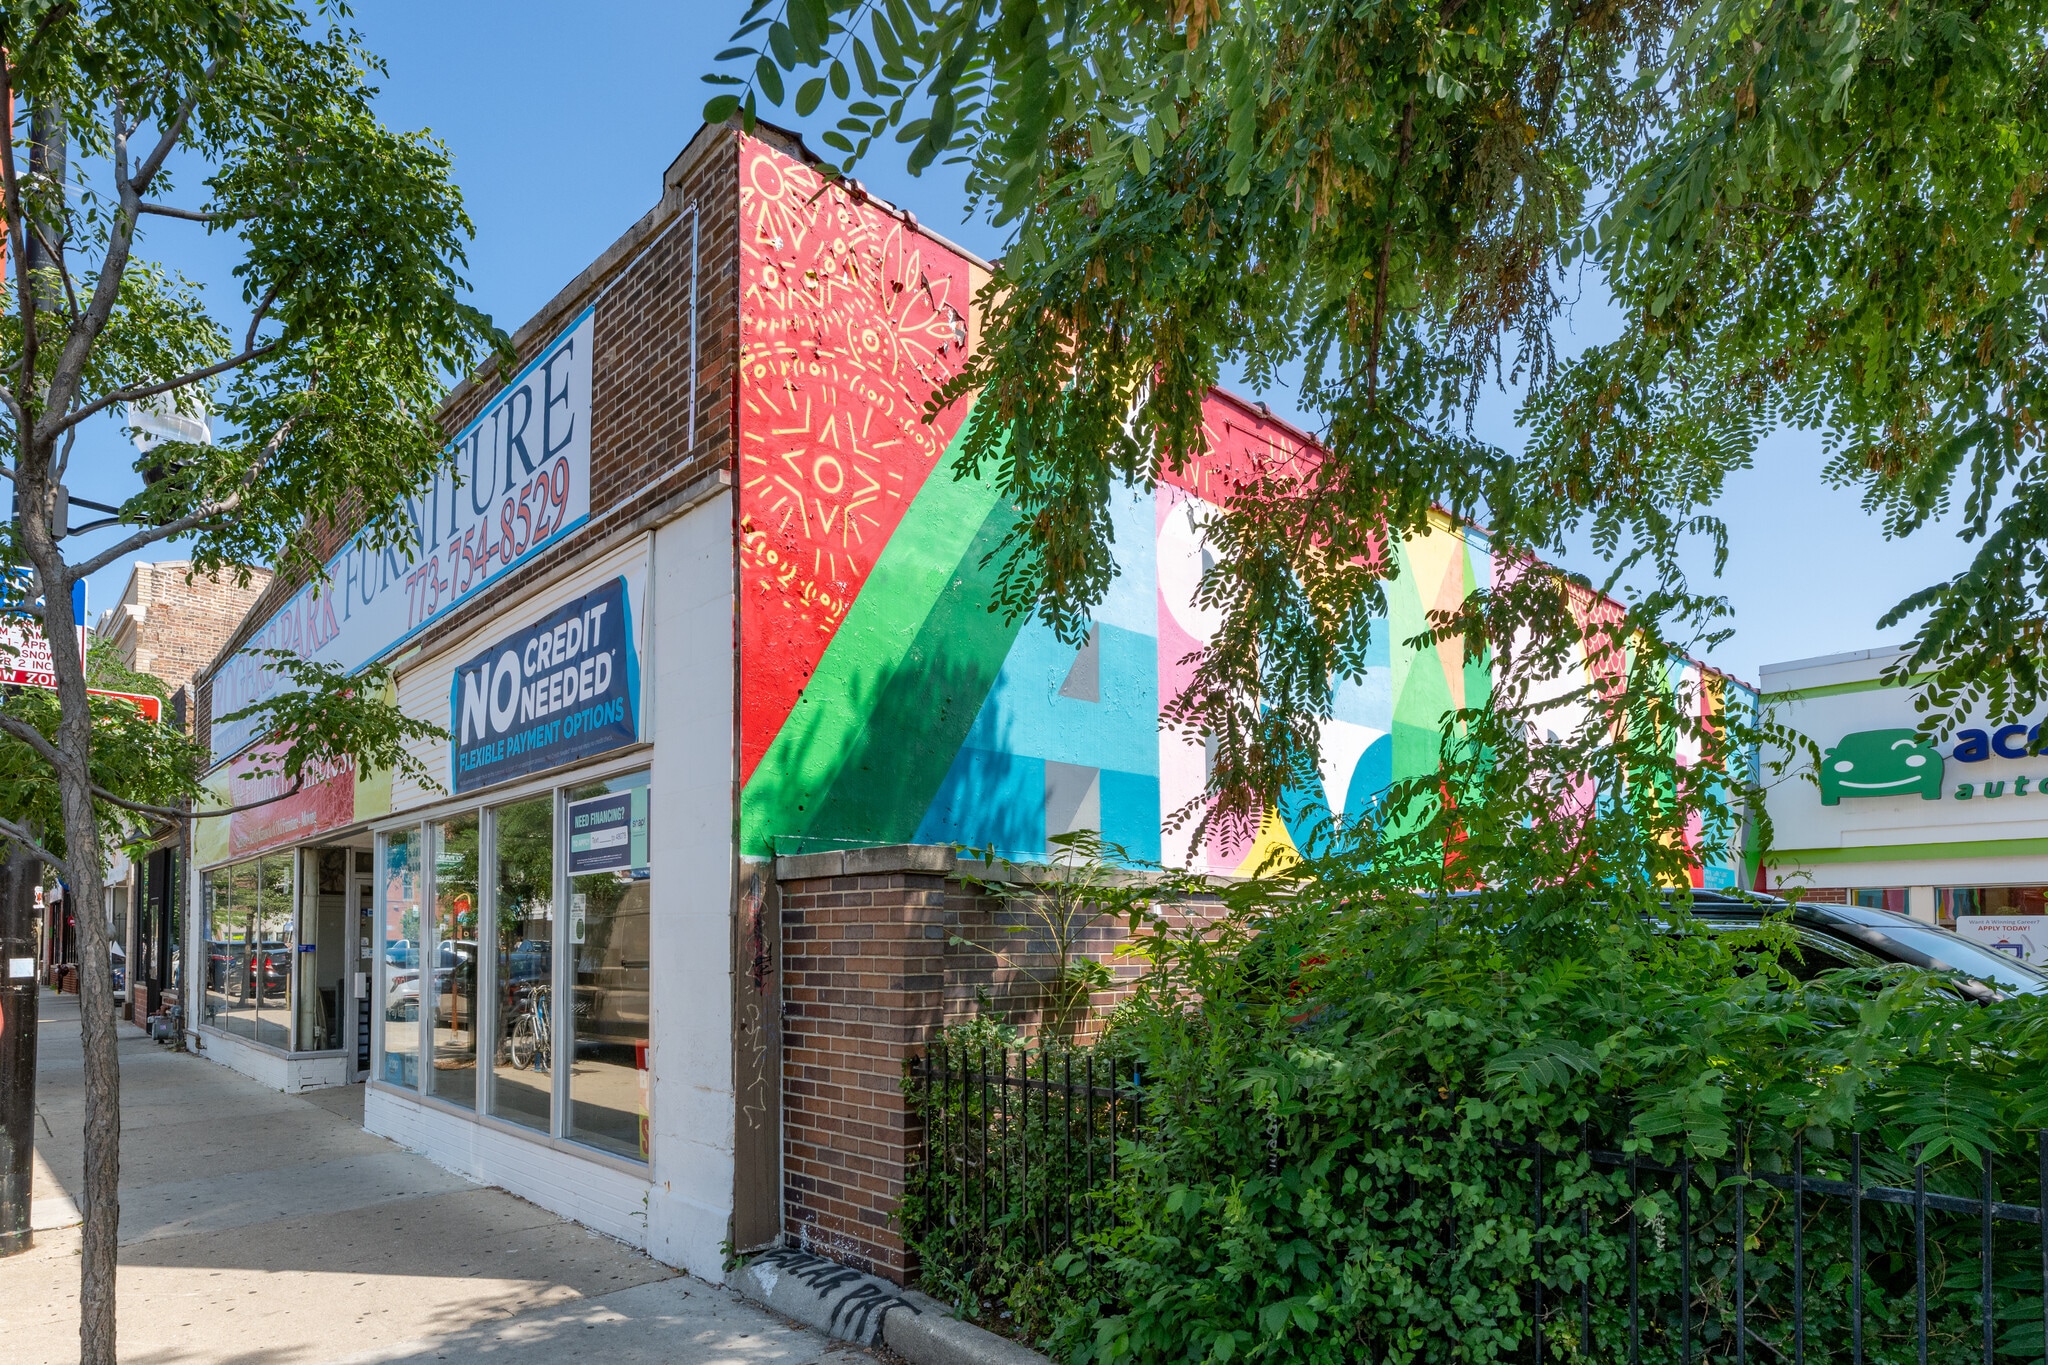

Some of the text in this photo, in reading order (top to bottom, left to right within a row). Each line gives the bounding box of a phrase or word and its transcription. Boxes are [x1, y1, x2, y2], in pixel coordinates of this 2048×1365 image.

[279, 562, 340, 680] PARK
[343, 336, 575, 623] FURNITURE
[404, 455, 570, 631] 773-754-8529
[459, 742, 505, 773] FLEXIBLE
[506, 718, 561, 758] PAYMENT
[563, 696, 625, 740] OPTIONS
[460, 601, 608, 746] NO CREDIT
[575, 807, 625, 828] NEED FINANCING?
